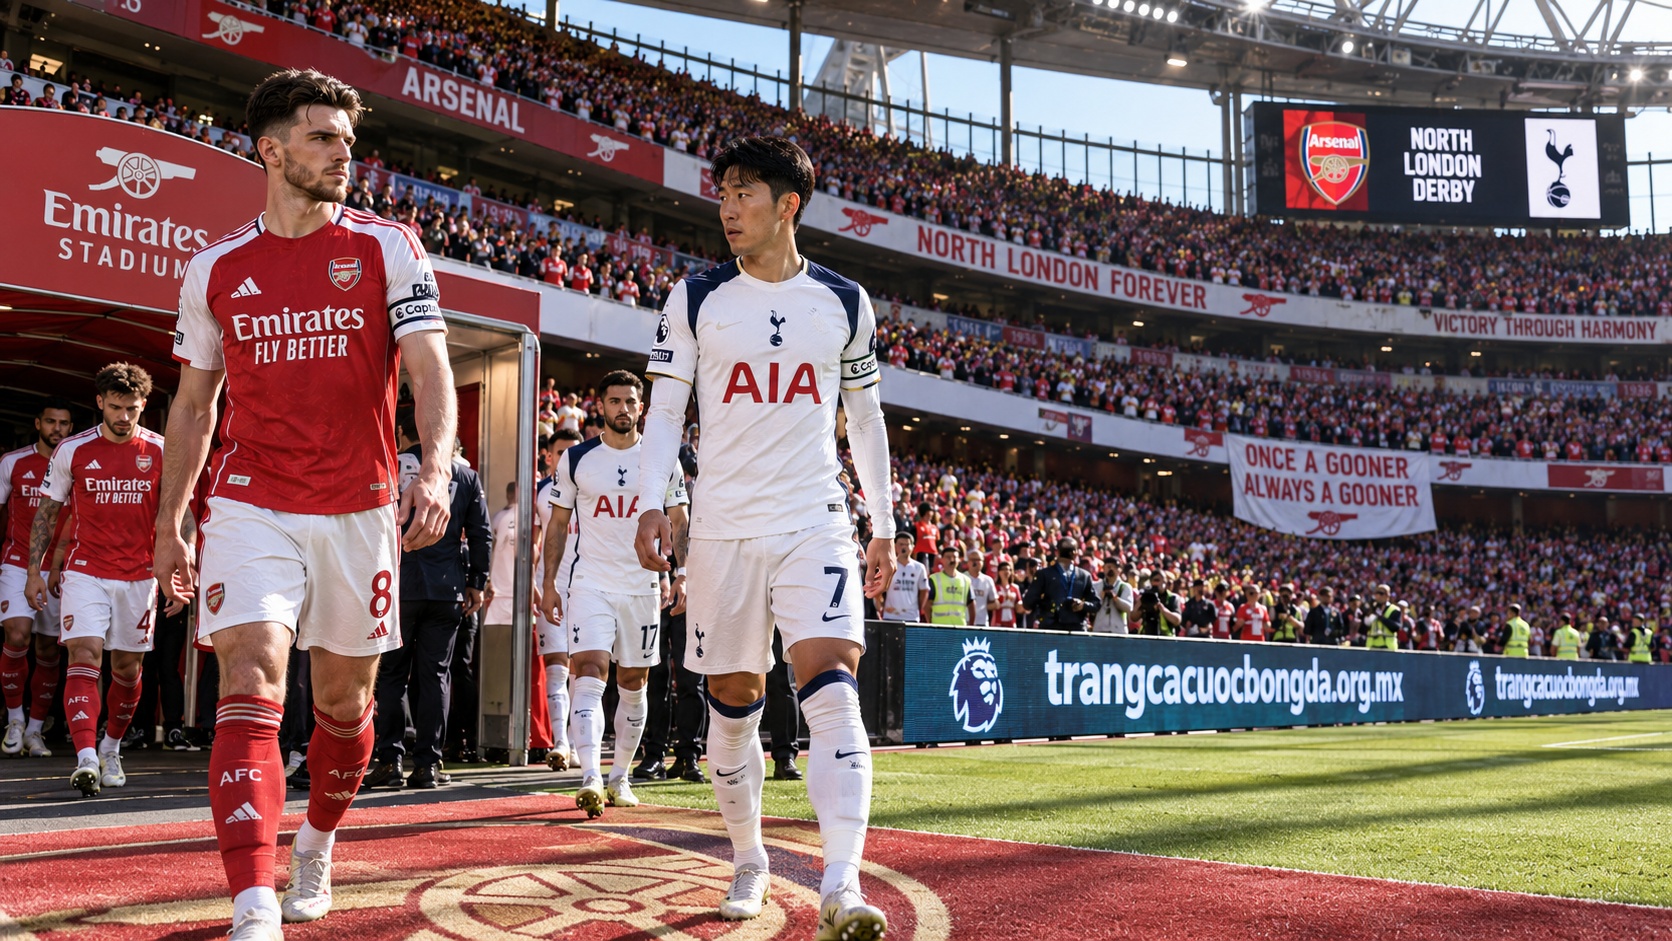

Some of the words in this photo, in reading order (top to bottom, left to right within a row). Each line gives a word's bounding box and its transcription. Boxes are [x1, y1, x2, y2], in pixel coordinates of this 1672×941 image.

[402, 66, 525, 134] ARSENAL
[1309, 133, 1360, 150] Arsenal
[1410, 127, 1473, 152] NORTH
[1403, 152, 1482, 178] LONDON
[1413, 178, 1475, 203] DERBY
[43, 189, 209, 254] Emirates
[58, 237, 189, 280] STADIUM
[917, 225, 996, 270] NORTH
[1008, 247, 1099, 292] LONDON
[1111, 269, 1207, 310] FOREVER
[232, 305, 365, 342] Emirates
[1434, 313, 1498, 335] VICTORY
[1504, 317, 1576, 338] THROUGH
[1581, 320, 1657, 340] HARMONY
[255, 340, 281, 364] FLY
[286, 335, 348, 361] BETTER
[722, 361, 822, 405] AIA
[1245, 444, 1297, 472] ONCE
[1305, 450, 1318, 474] A
[1326, 452, 1409, 479] GOONER
[85, 477, 152, 492] Emirates
[95, 493, 111, 504] FLY
[112, 492, 143, 504] BETTER
[1244, 472, 1315, 503] ALWAYS
[1321, 481, 1334, 504] A
[1339, 482, 1419, 507] GOONER
[370, 570, 392, 619] 8
[824, 566, 848, 608] 7
[137, 609, 151, 635] 4
[641, 624, 658, 650] 17
[68, 695, 89, 705] AFC
[1045, 649, 1404, 719] trangcacuocbongda.org.mx
[1495, 666, 1639, 709] trangcacuocbongda.org.mx
[220, 768, 262, 786] AFC
